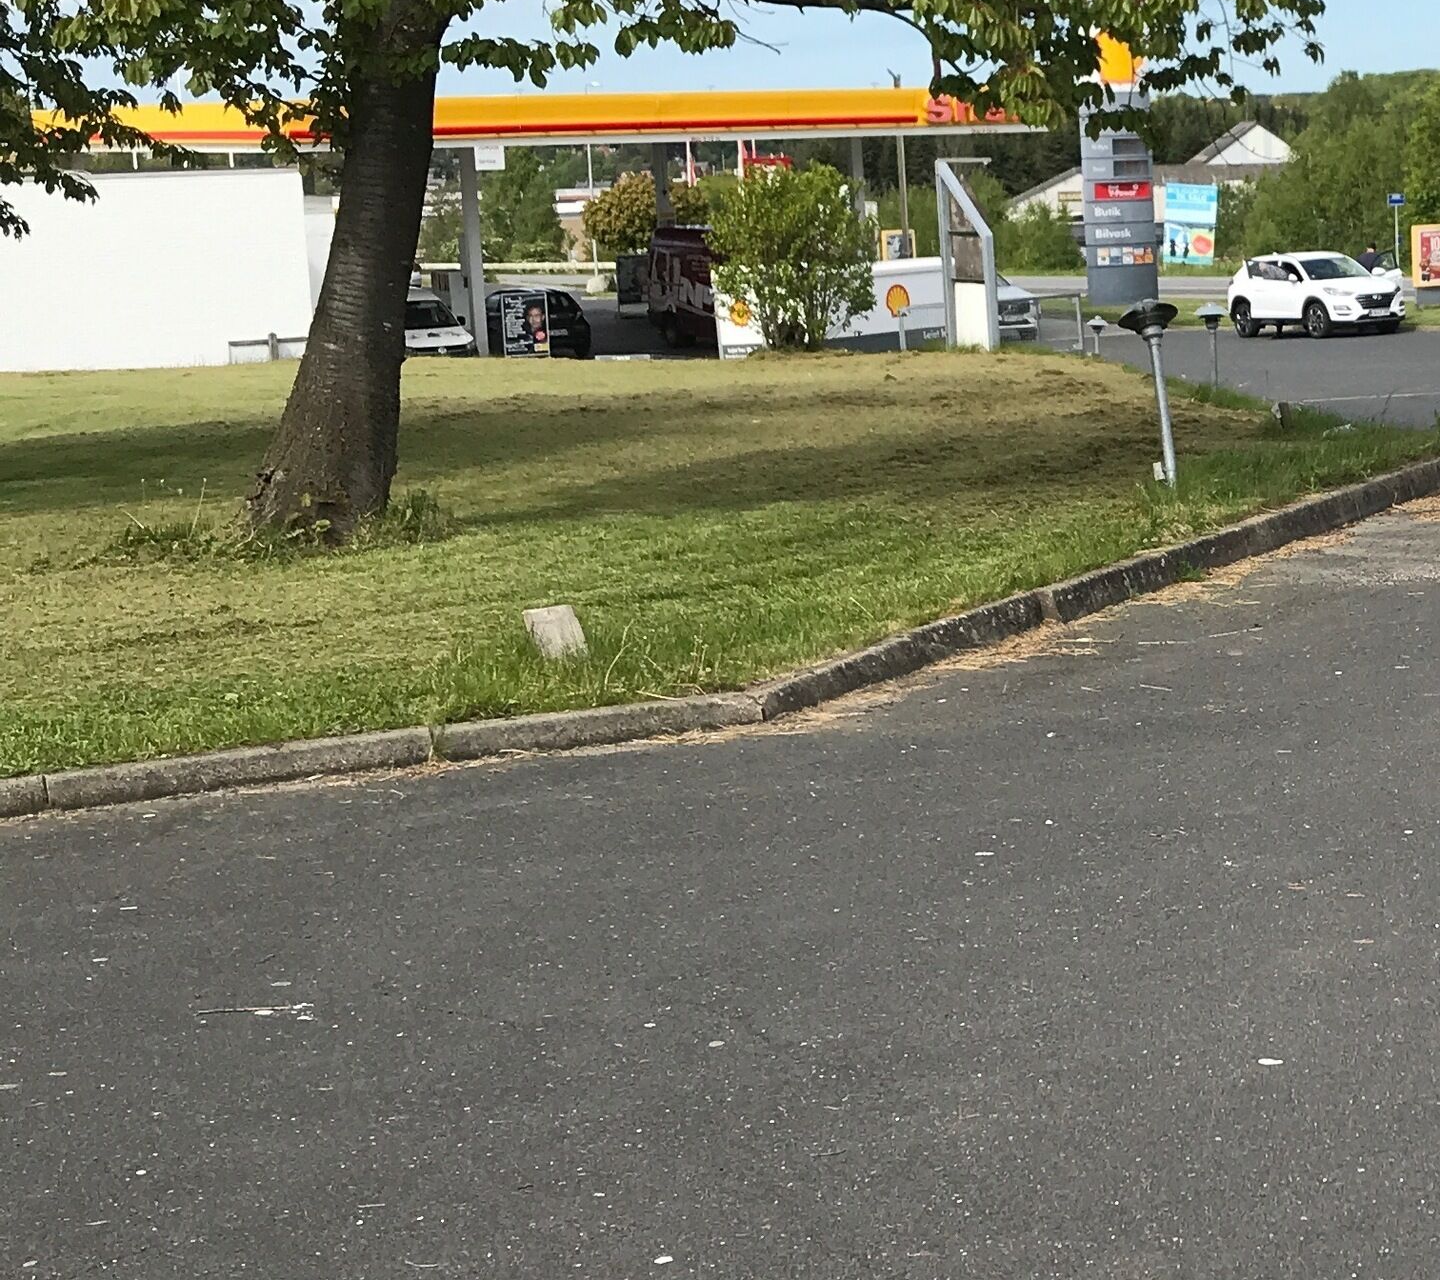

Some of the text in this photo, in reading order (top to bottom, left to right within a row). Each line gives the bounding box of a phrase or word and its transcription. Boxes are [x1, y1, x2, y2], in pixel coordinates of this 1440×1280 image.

[1095, 206, 1121, 217] Butik
[1095, 228, 1131, 239] Bilvask
[1430, 236, 1440, 251] 10
